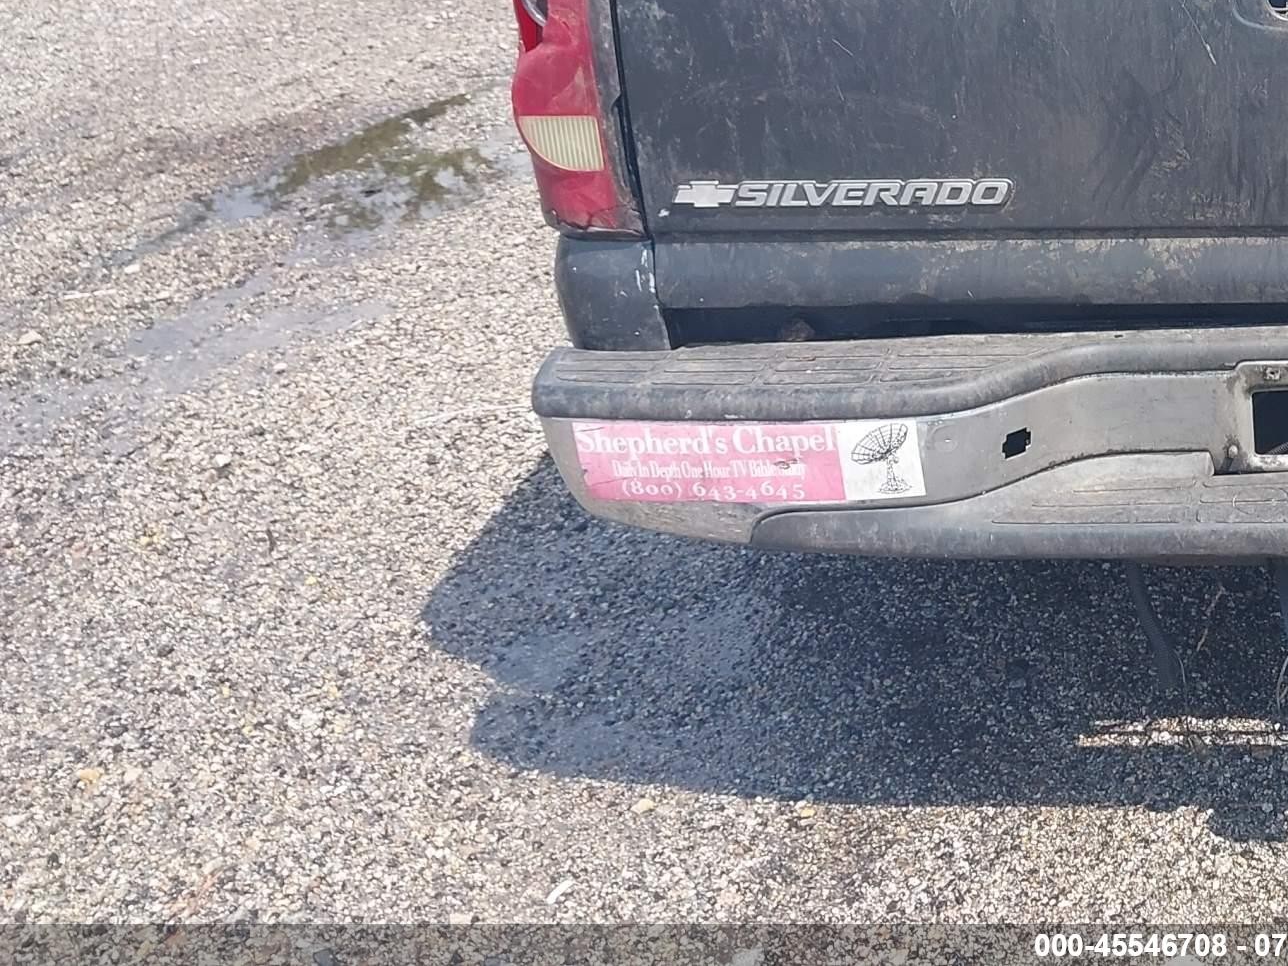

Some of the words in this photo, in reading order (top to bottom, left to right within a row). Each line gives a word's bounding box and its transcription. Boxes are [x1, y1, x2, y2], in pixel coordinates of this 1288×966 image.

[735, 178, 1013, 208] SILVERADO
[575, 424, 729, 461] Shepherd's
[732, 424, 837, 458] Chapel
[649, 460, 681, 482] Depth
[681, 460, 703, 478] One
[703, 460, 730, 478] Hour
[730, 459, 748, 478] TV
[622, 478, 682, 497] (800)
[692, 480, 806, 501] 643-4645
